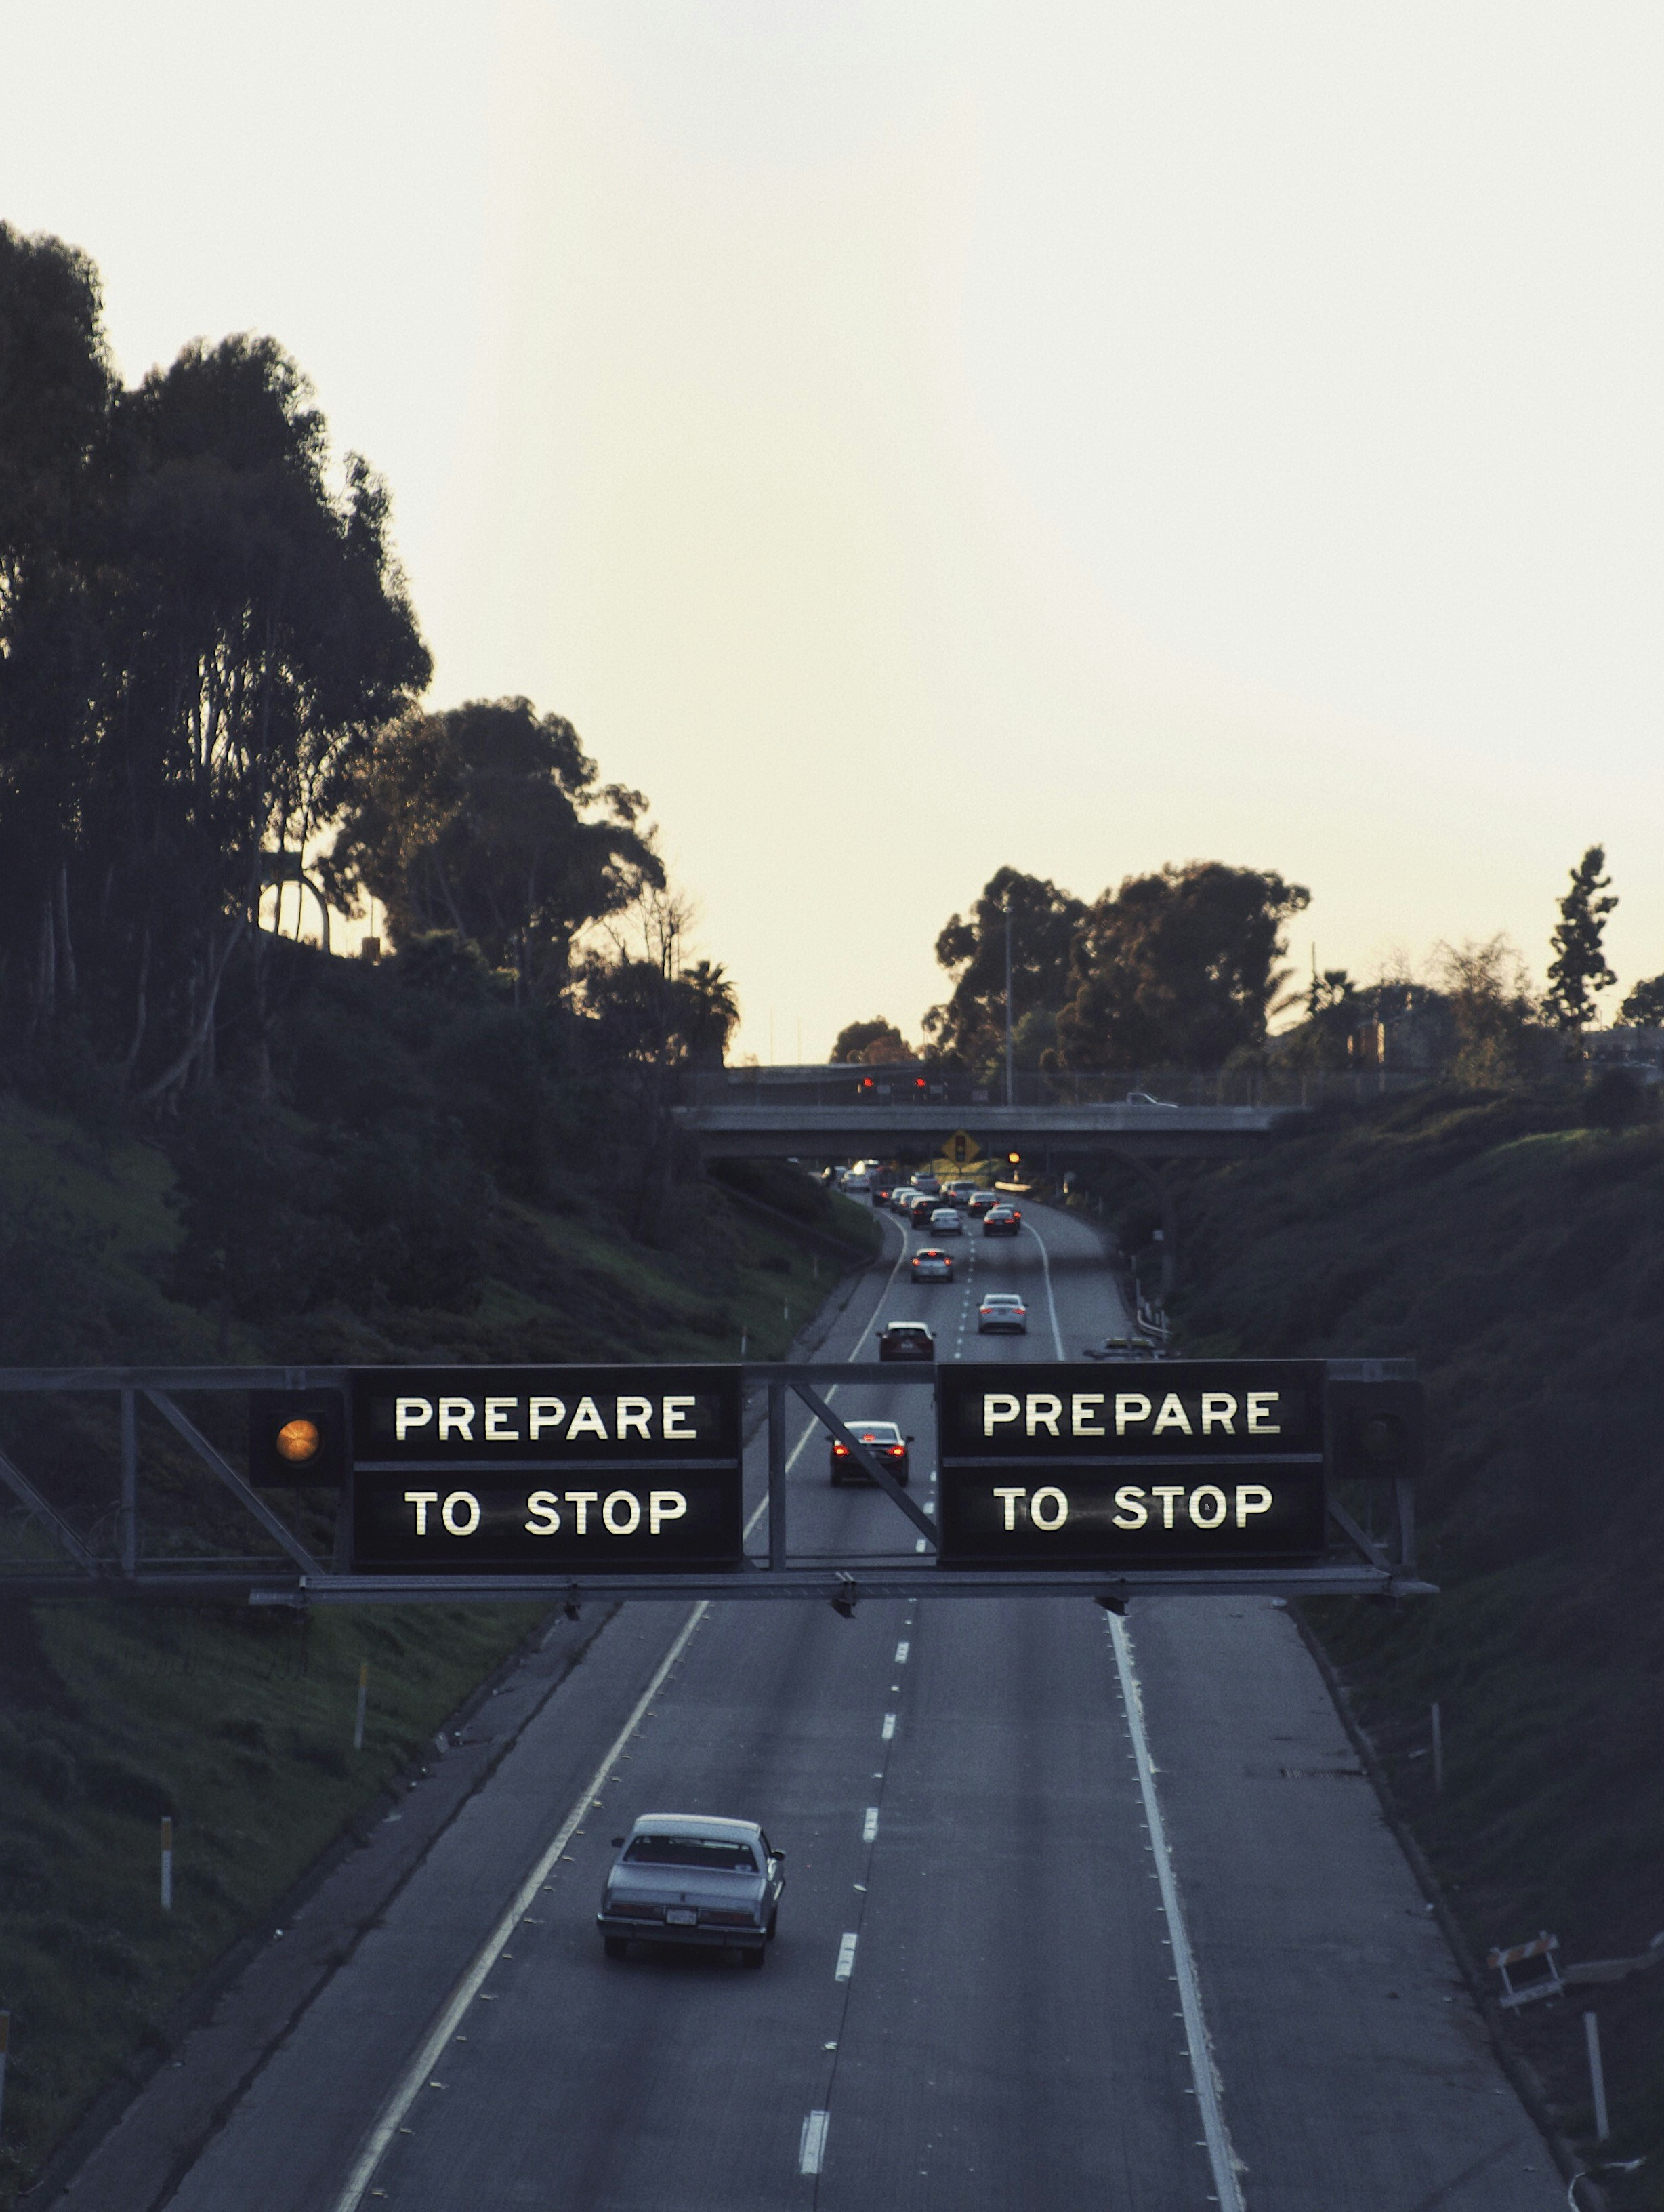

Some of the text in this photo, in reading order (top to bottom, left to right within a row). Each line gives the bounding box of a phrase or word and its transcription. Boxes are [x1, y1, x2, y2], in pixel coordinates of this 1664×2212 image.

[396, 1396, 698, 1441] PREPARE
[984, 1392, 1281, 1437] PREPARE
[404, 1490, 687, 1536] TO STOP
[993, 1485, 1273, 1531] TO STOP
